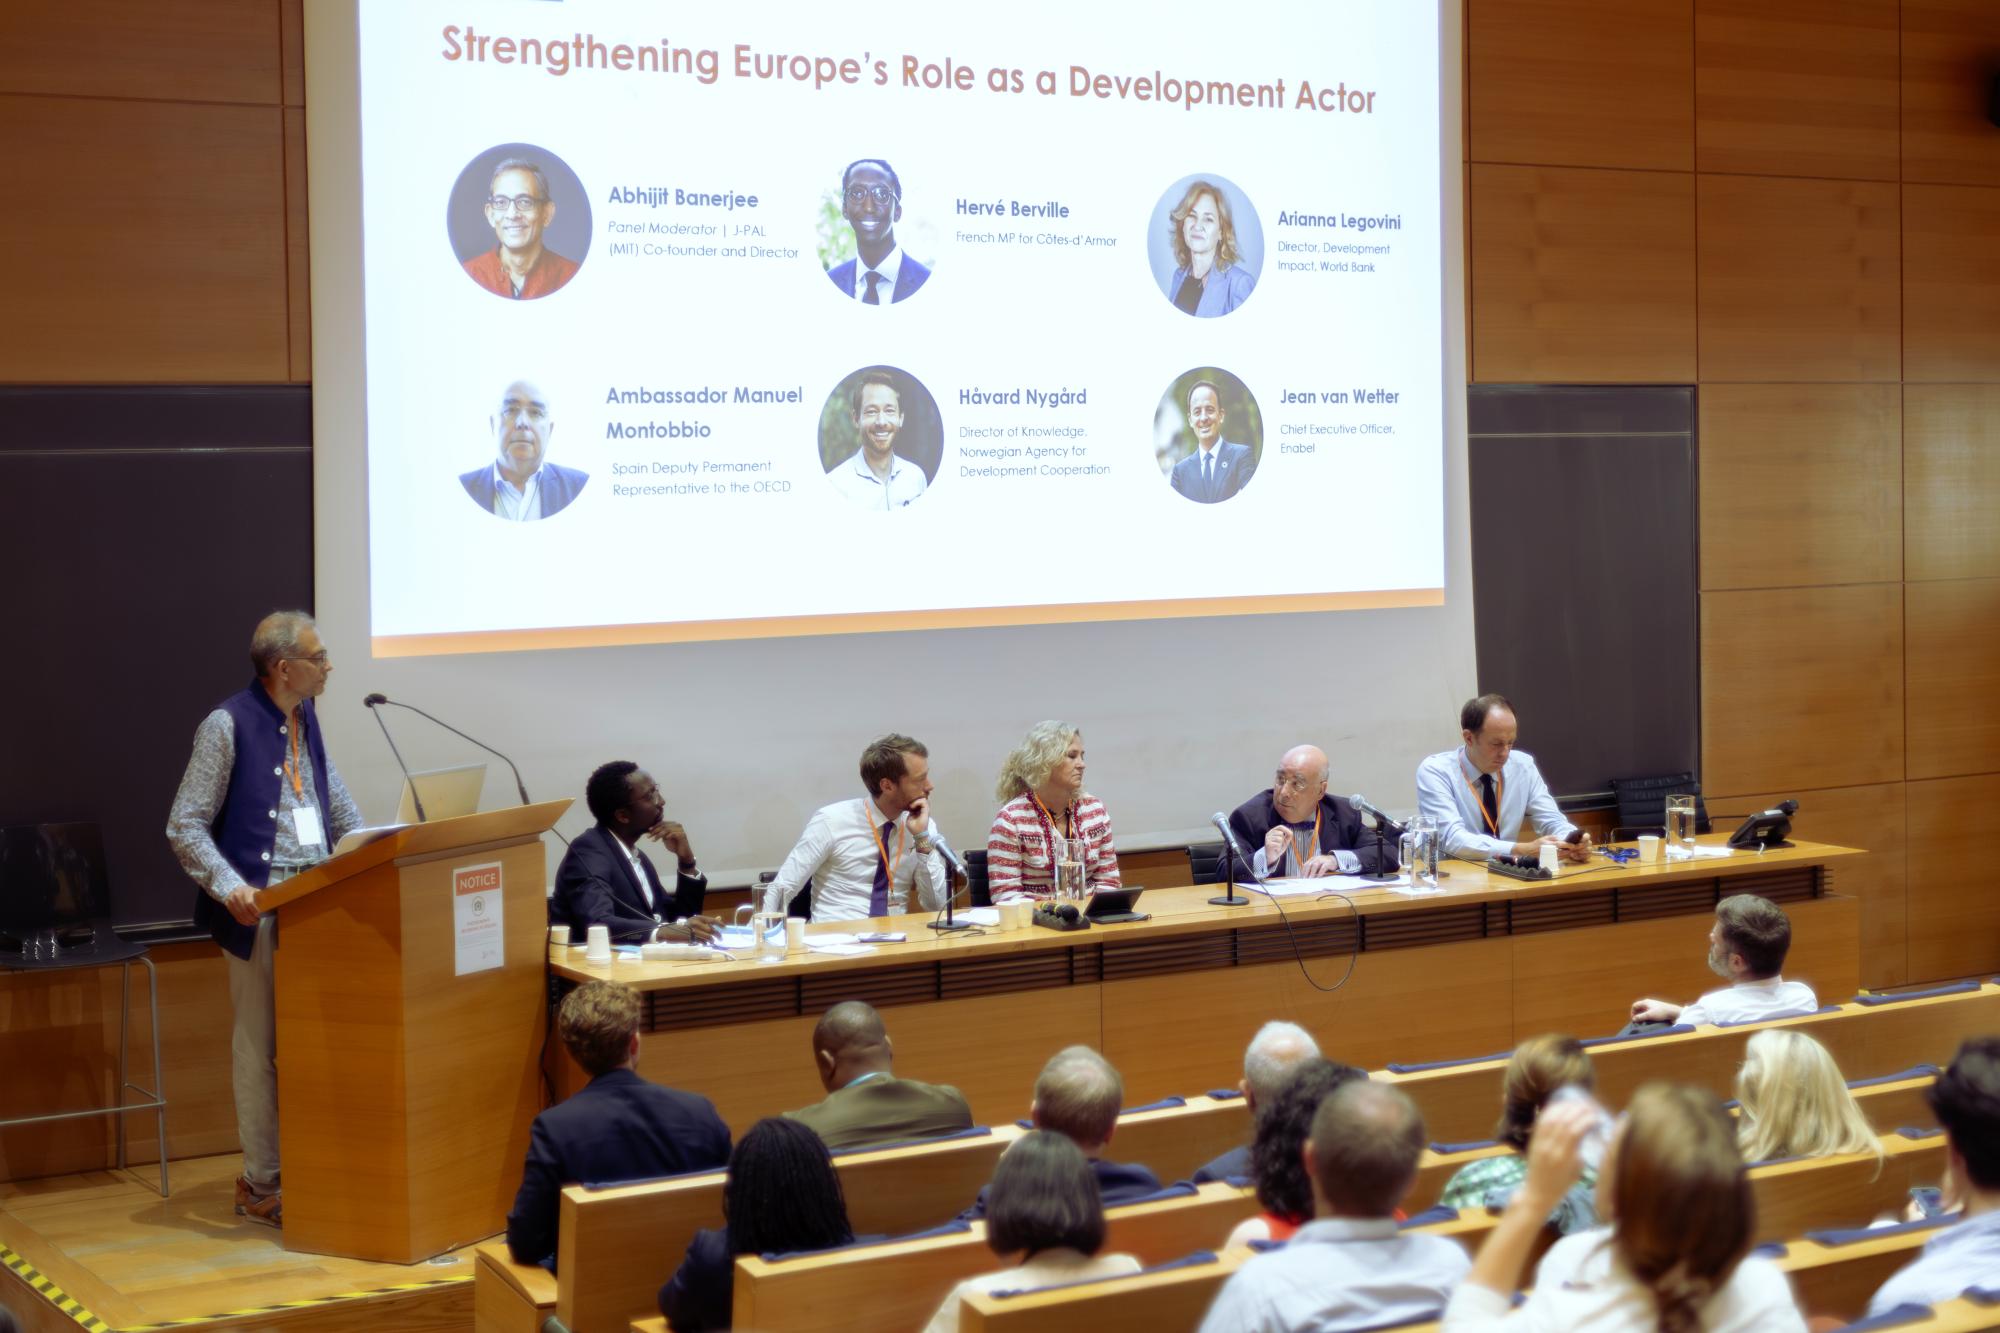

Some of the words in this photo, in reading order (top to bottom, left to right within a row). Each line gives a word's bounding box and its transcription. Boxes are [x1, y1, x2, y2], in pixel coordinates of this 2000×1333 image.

[443, 26, 718, 84] Strengthening
[735, 44, 888, 90] Europe's
[903, 55, 975, 90] Role
[987, 68, 1024, 93] as
[1036, 71, 1056, 95] a
[1070, 66, 1285, 111] Development
[1295, 81, 1376, 113] Actor
[607, 185, 670, 209] Abhijit
[675, 188, 759, 212] Banerjee
[956, 198, 1006, 217] Hervé
[1010, 200, 1070, 219] Berville
[607, 220, 646, 234] Panel
[648, 222, 717, 236] Moderator
[733, 224, 767, 237] J-PAL
[1277, 210, 1337, 228] Arianna
[1340, 212, 1402, 233] Legovini
[956, 230, 995, 244] French
[997, 232, 1016, 244] MP
[1018, 232, 1034, 245] for
[609, 242, 639, 257] (MIT)
[643, 243, 718, 257] Co-founder
[720, 245, 747, 258] and
[750, 245, 799, 259] Director
[1277, 240, 1322, 254] Director,
[1323, 242, 1391, 256] Development
[1277, 259, 1317, 273] Impact,
[1319, 260, 1349, 273] World
[1351, 261, 1376, 273] Bank
[605, 385, 728, 405] Ambassador
[733, 385, 803, 404] Manuel
[959, 386, 1021, 405] Håvard
[1026, 386, 1087, 409] Nygård
[1280, 388, 1317, 404] Jean
[1320, 392, 1349, 404] van
[1352, 388, 1400, 404] Wetter
[606, 420, 712, 440] Montobbio
[959, 426, 1005, 438] Director
[1007, 426, 1019, 438] of
[1279, 423, 1307, 435] Chief
[1309, 424, 1357, 435] Executive
[1359, 423, 1396, 435] Officer,
[959, 446, 1022, 460] Norwegian
[1024, 446, 1069, 460] Agency
[1071, 445, 1087, 457] for
[1280, 442, 1316, 454] Enabel
[612, 462, 649, 477] Spain
[652, 461, 699, 476] Deputy
[702, 460, 772, 473] Permanent
[960, 465, 1037, 479] Development
[1040, 463, 1111, 477] Cooperation
[613, 482, 710, 498] Representative
[713, 482, 726, 494] to
[729, 481, 751, 493] the
[753, 480, 791, 493] OECD
[459, 872, 497, 890] NOTICE
